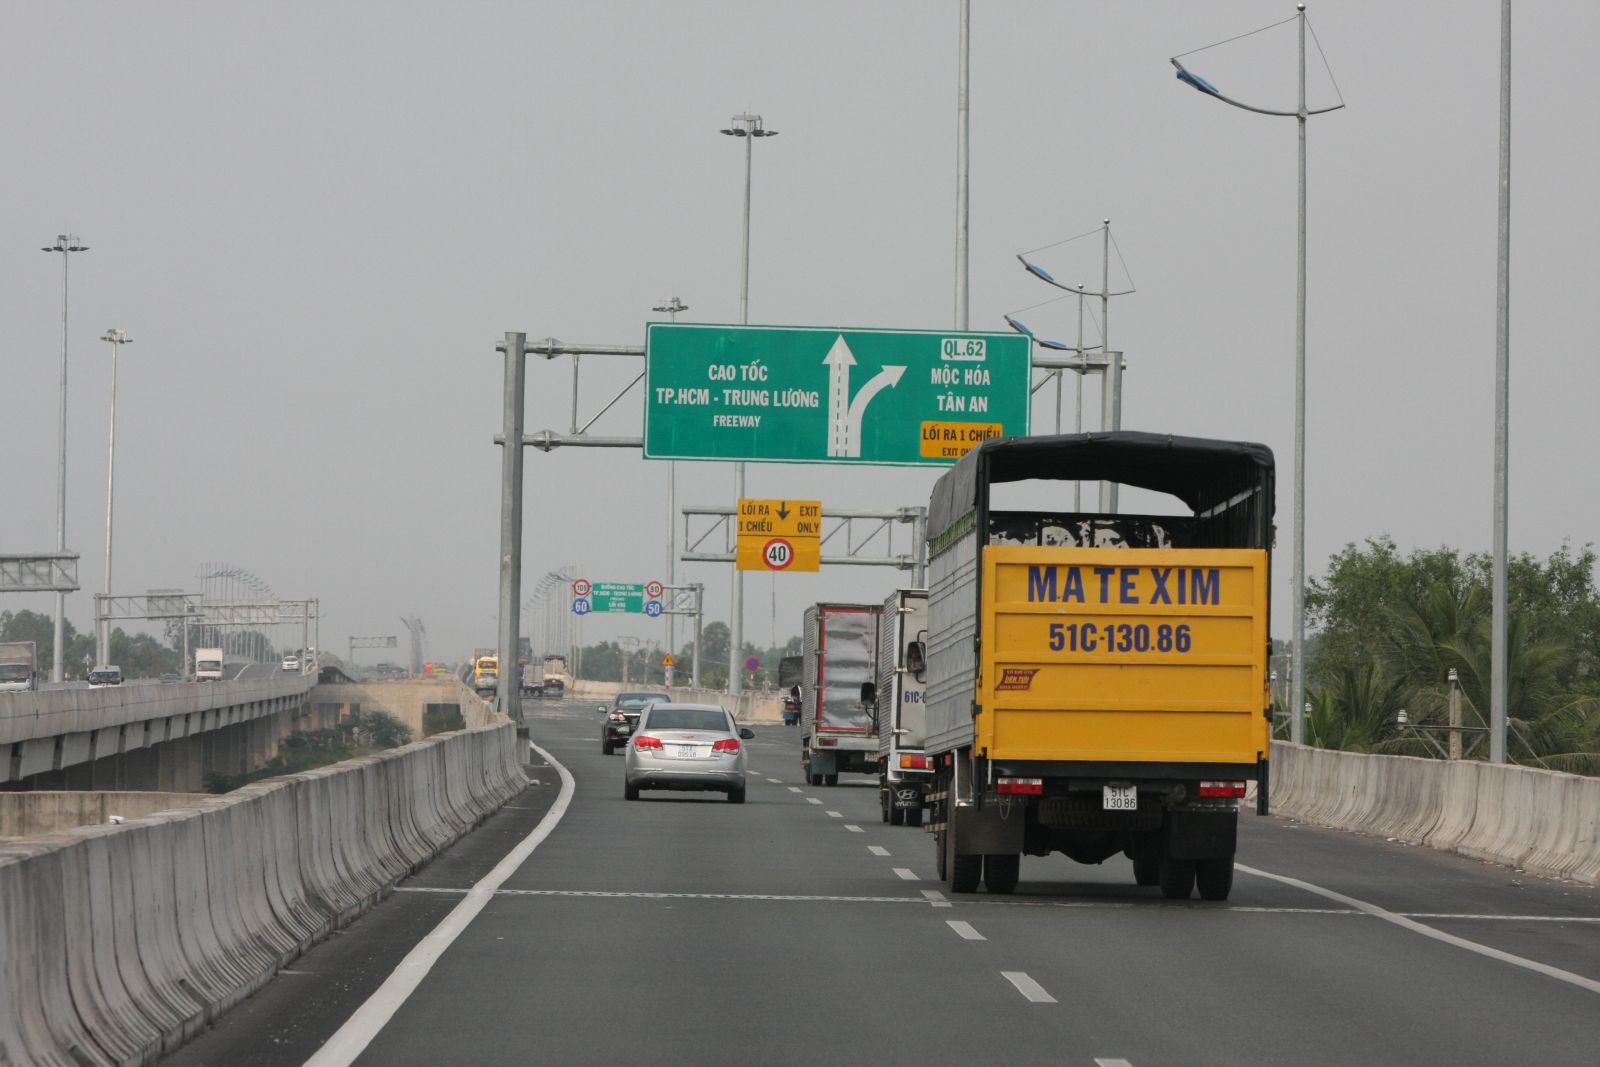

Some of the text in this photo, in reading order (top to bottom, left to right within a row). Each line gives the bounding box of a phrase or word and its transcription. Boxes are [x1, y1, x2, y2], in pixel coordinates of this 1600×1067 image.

[943, 340, 984, 359] QL.62
[708, 359, 768, 381] CAO TỐC
[931, 363, 991, 388] MỘC HÓA
[656, 387, 709, 405] TP.HCM
[723, 389, 769, 406] TRUNG
[773, 388, 819, 408] LƯƠNG
[937, 391, 988, 413] TÂN AN
[713, 415, 761, 428] FREEWAY
[943, 429, 957, 441] RA
[959, 429, 965, 442] 1
[942, 447, 958, 457] EXIT
[758, 504, 770, 516] RA
[799, 505, 819, 517] EXIT
[797, 521, 820, 533] ONLY
[768, 545, 787, 562] 40
[575, 600, 587, 612] 60
[647, 603, 660, 615] 50
[1049, 623, 1191, 653] 51C-130.86
